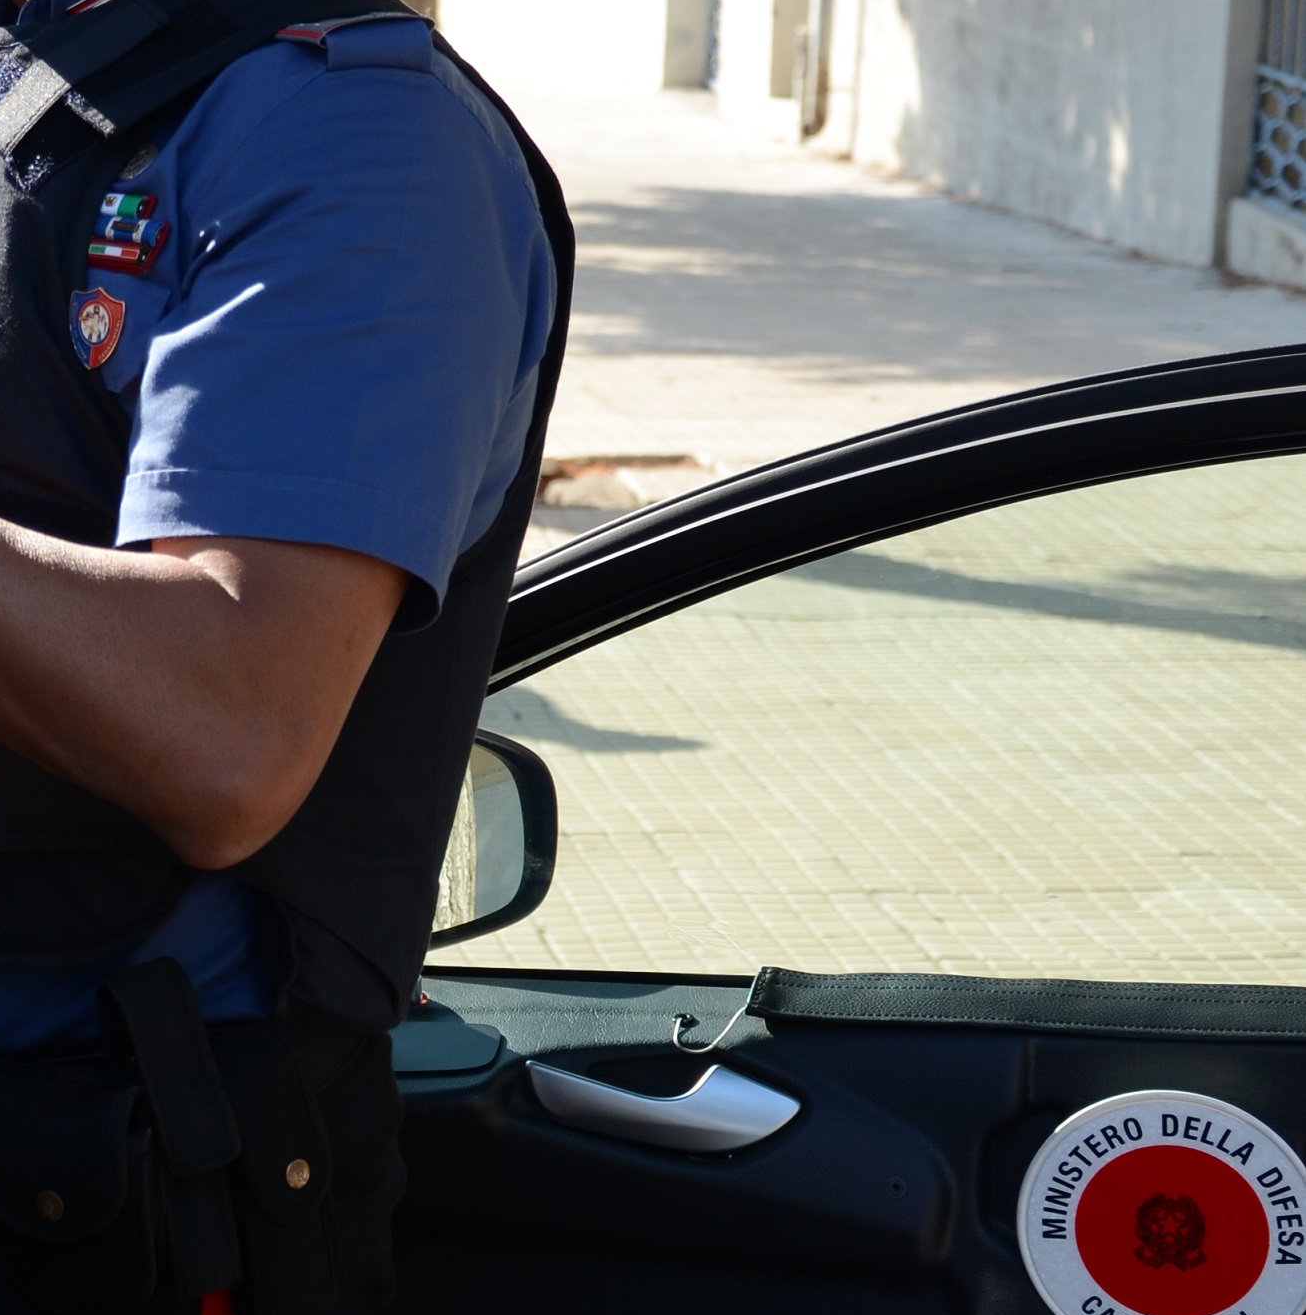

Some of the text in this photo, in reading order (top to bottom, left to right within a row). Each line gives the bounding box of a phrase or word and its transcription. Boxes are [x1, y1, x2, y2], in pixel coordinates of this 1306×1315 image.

[1041, 1113, 1305, 1266] MINISTERO DELLA DIFESA
